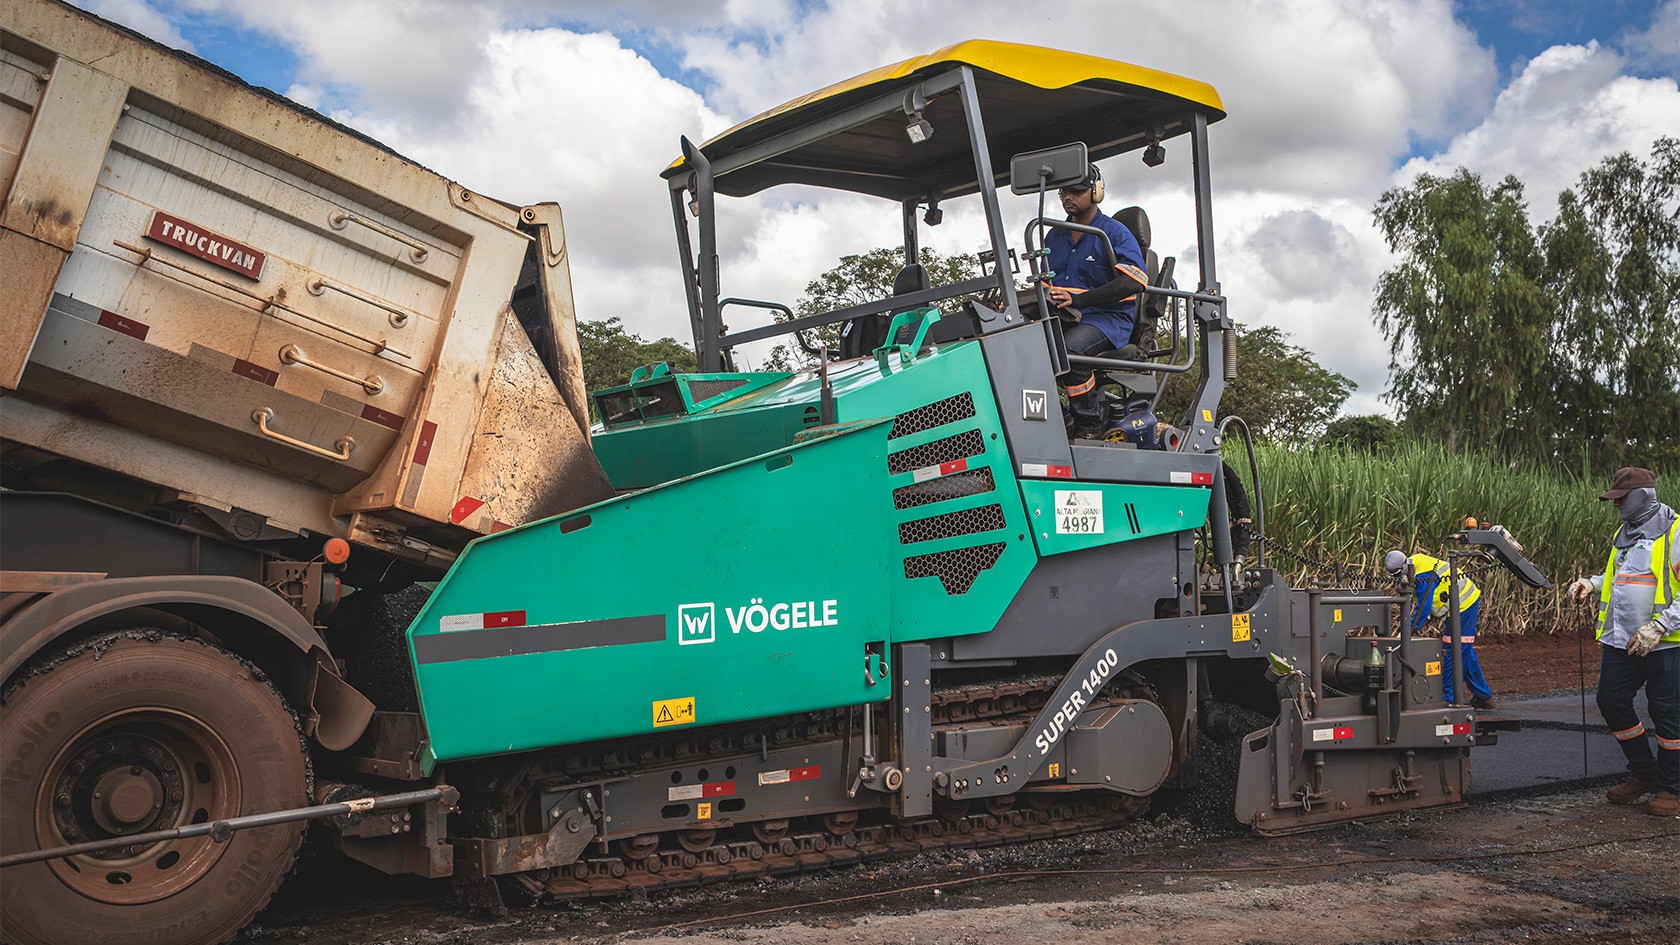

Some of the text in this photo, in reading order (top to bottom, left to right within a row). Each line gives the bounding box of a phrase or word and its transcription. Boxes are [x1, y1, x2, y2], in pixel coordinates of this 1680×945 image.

[162, 221, 256, 270] TRUCKVAN
[1062, 516, 1097, 533] 4987
[725, 597, 838, 634] VÖGELE
[1035, 648, 1118, 755] SUPER 1400
